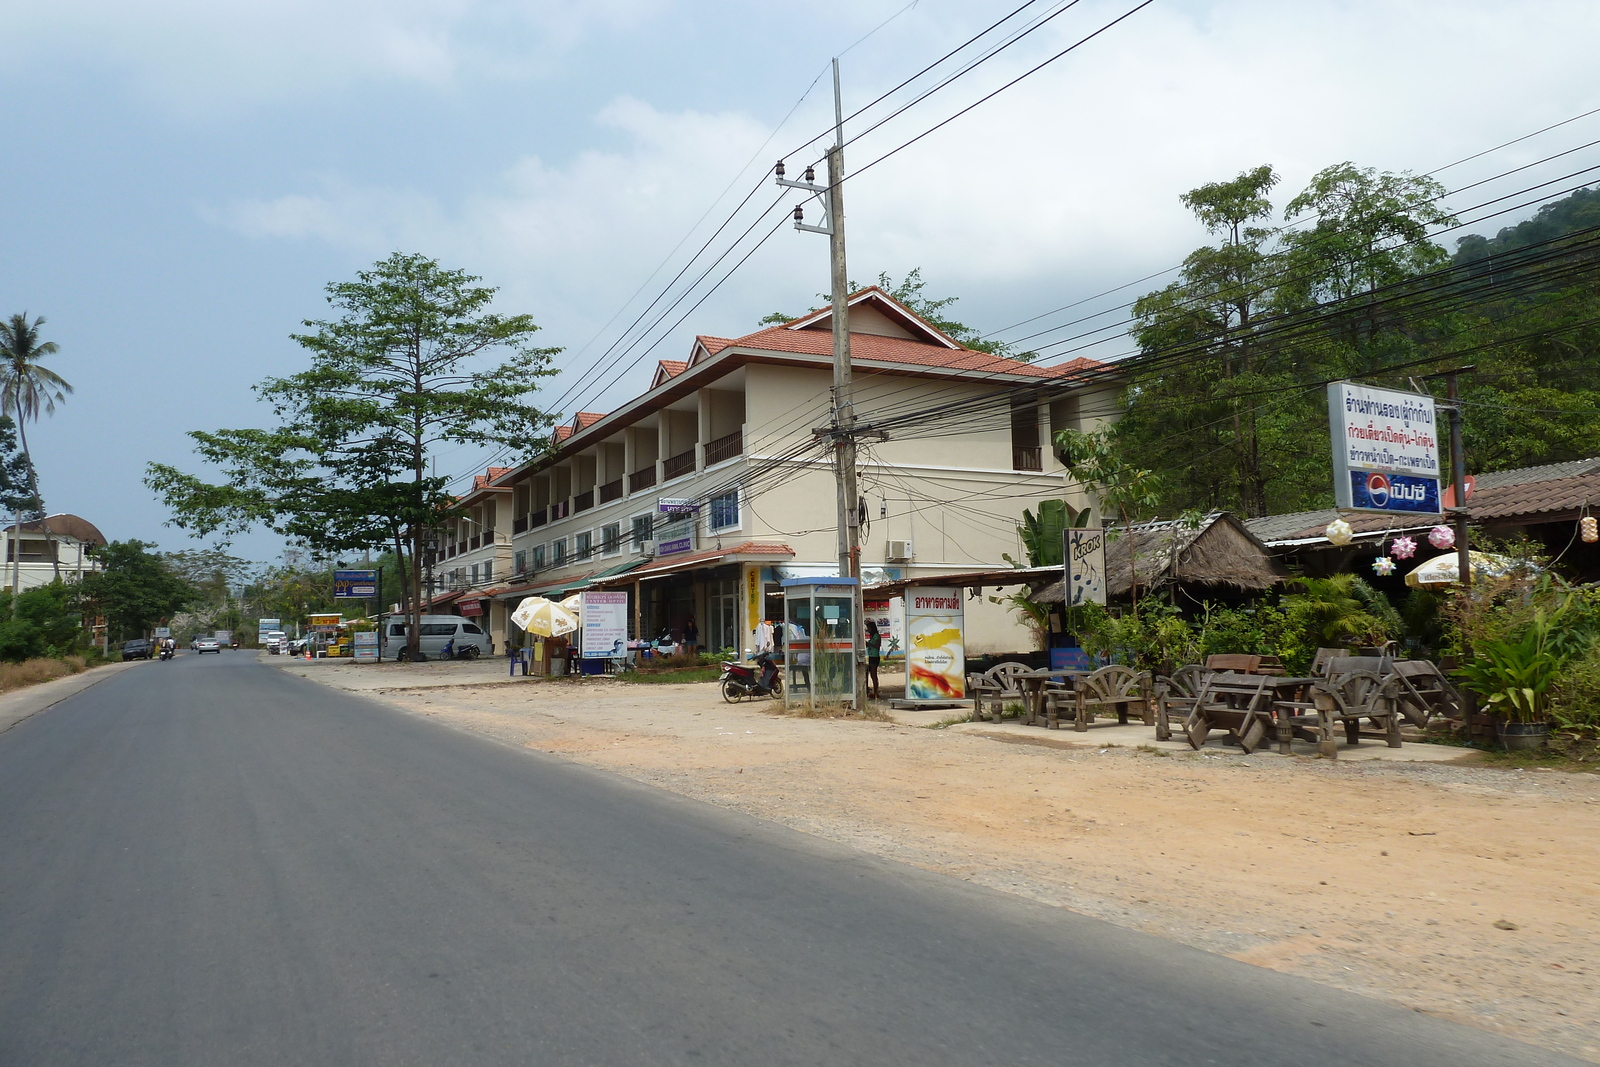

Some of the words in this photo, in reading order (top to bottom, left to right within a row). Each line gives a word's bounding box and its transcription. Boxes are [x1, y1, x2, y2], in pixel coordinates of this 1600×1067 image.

[1073, 534, 1101, 561] KROK
[915, 590, 960, 610] อาหารตามสั่ง
